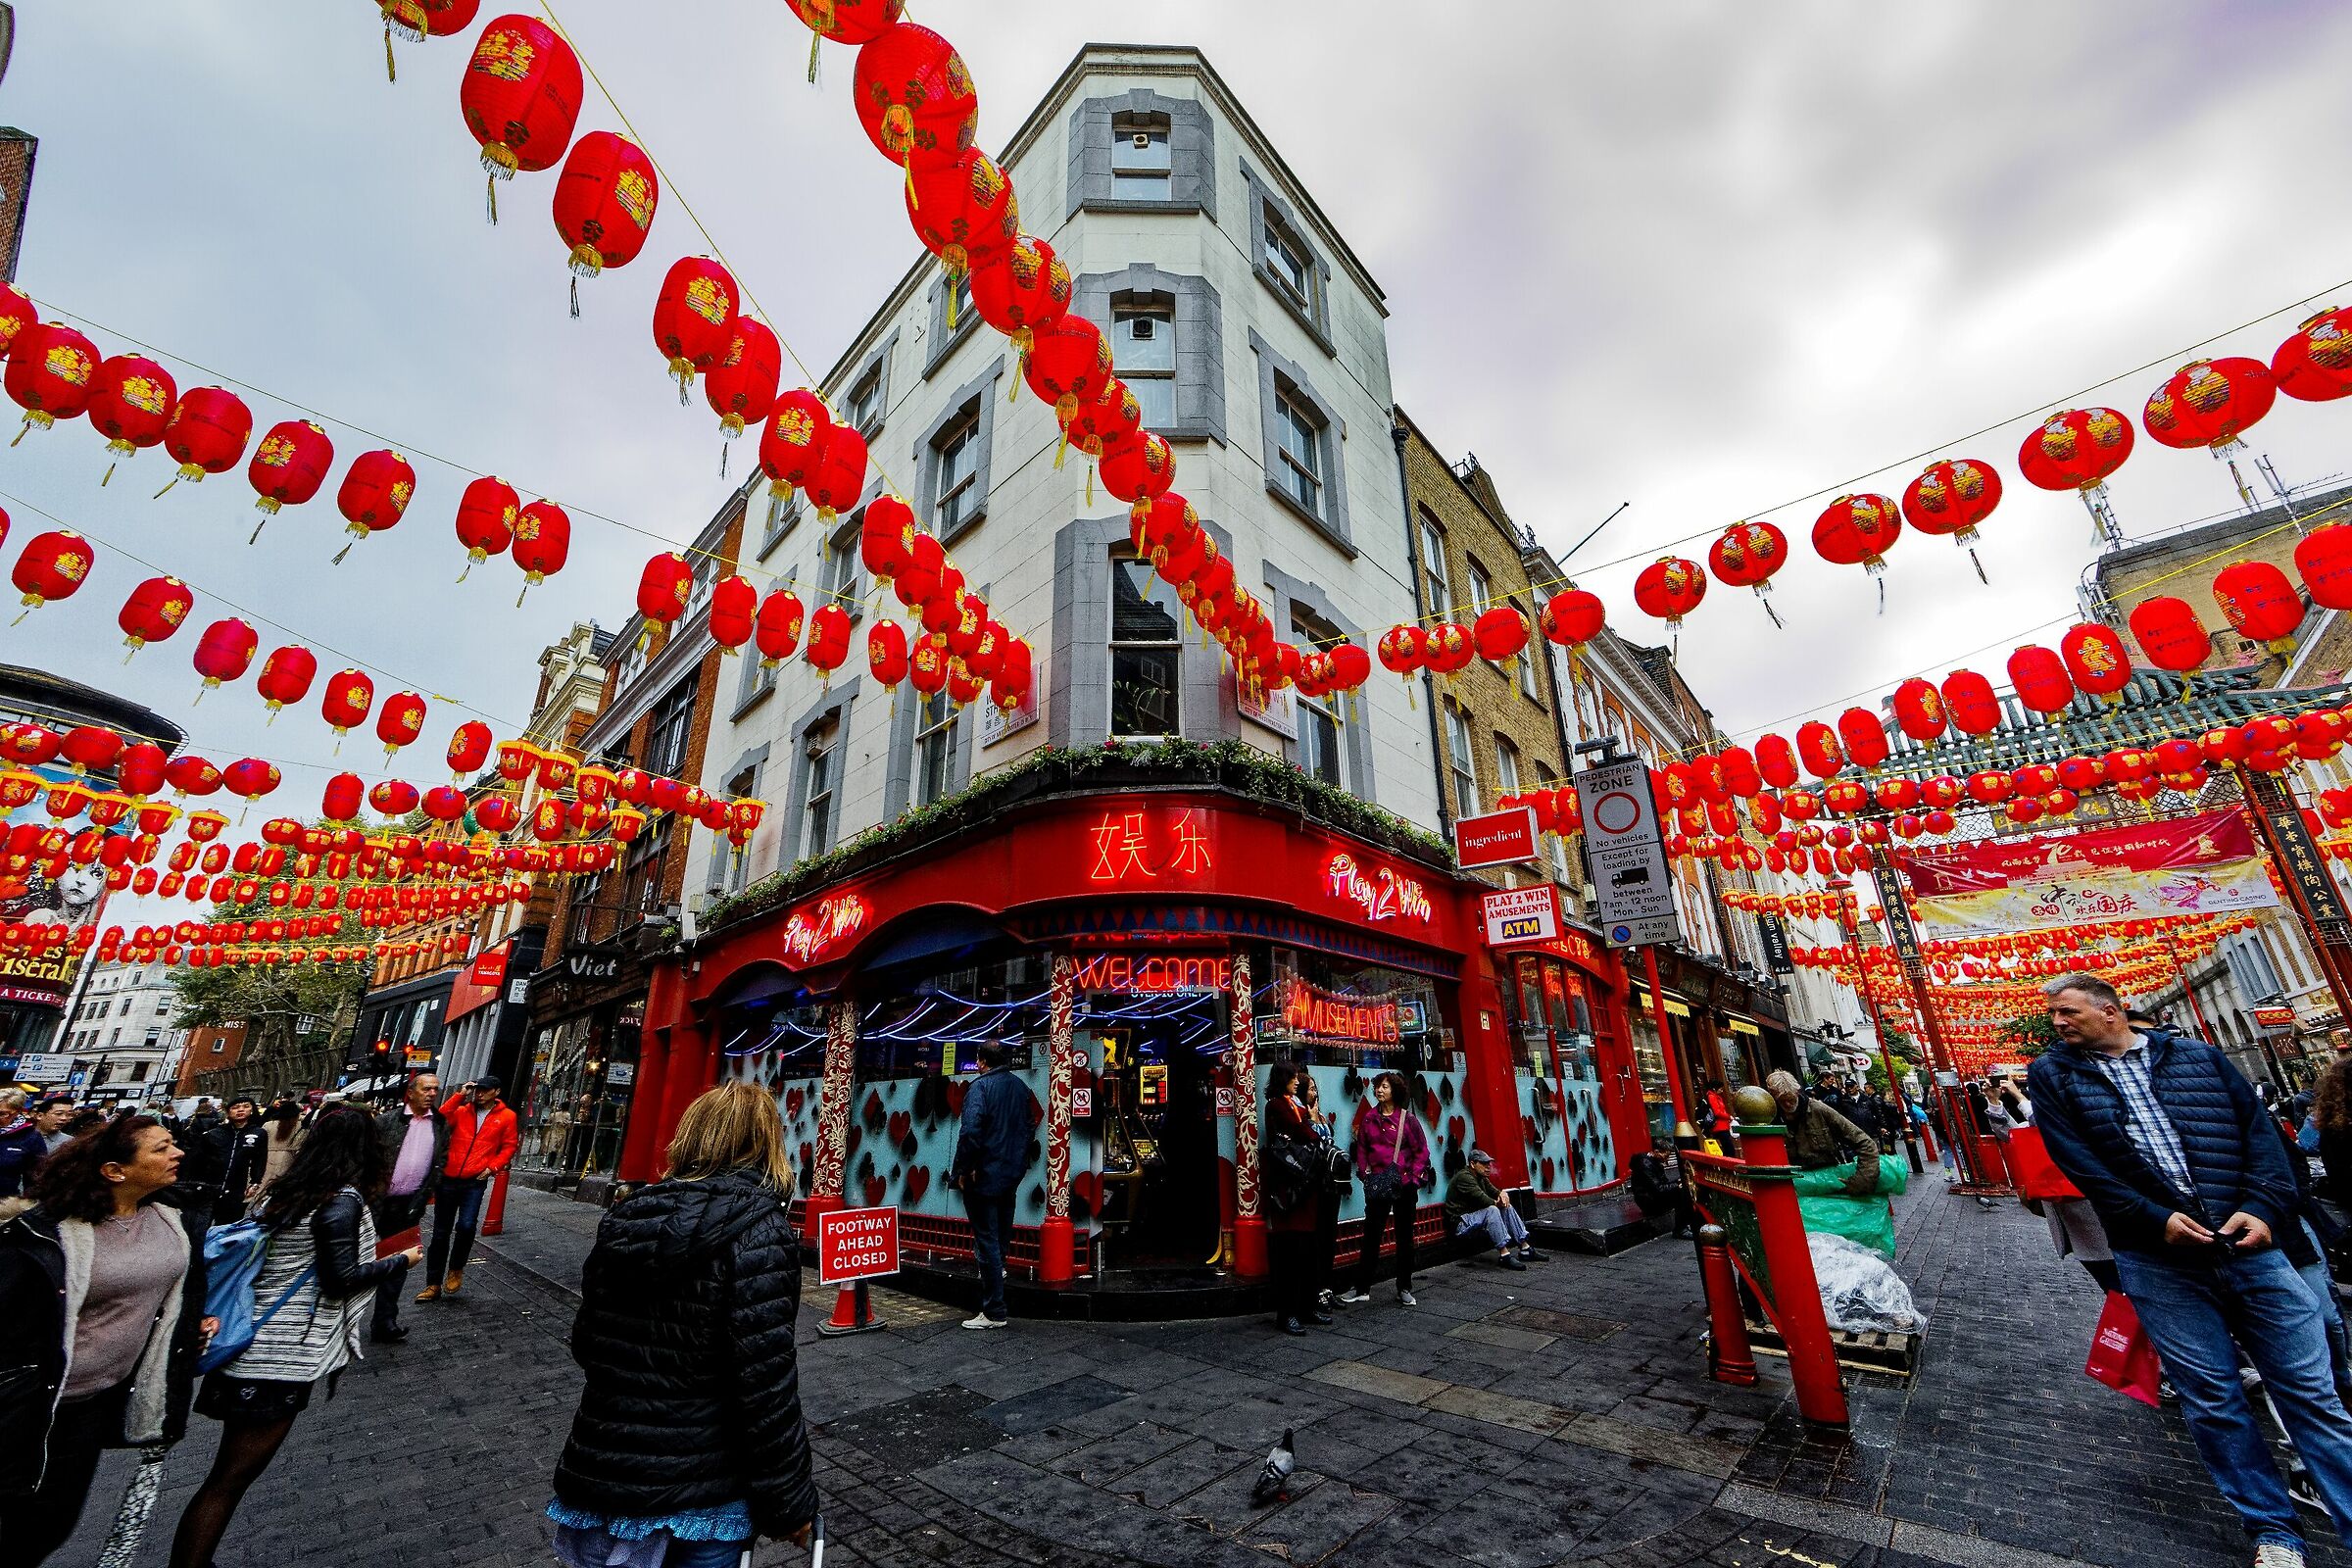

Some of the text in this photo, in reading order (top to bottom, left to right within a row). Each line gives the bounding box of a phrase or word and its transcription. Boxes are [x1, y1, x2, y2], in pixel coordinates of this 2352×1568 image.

[1579, 763, 1640, 783] PEDESTRIAN
[1590, 775, 1634, 794] ZONE
[1091, 809, 1211, 879] 娱乐
[1465, 828, 1522, 849] ingredient
[1611, 833, 1649, 846] vehicles
[1601, 850, 1633, 861] Except
[1603, 857, 1650, 870] loading by
[1330, 854, 1377, 920] Play
[1376, 867, 1396, 919] 2
[1613, 886, 1653, 899] between
[1486, 889, 1548, 908] PLAY 2 WIN
[1603, 901, 1623, 909] 7am
[1631, 896, 1642, 905] 12
[1643, 894, 1667, 904] noon
[1488, 903, 1550, 919] AMUSEMENTS
[1613, 908, 1634, 917] Mon
[1641, 905, 1659, 913] Sun
[810, 900, 832, 954] 2
[1503, 918, 1539, 938] ATM
[1652, 921, 1669, 930] any
[1644, 931, 1666, 940] time
[1770, 932, 1784, 959] valley
[570, 955, 617, 976] Viet
[1074, 957, 1230, 990] WELCOME
[1285, 984, 1398, 1042] AMUSEMENTS
[828, 1217, 891, 1235] FOOTWAY
[838, 1236, 884, 1251] AHEAD
[833, 1252, 888, 1270] CLOSED
